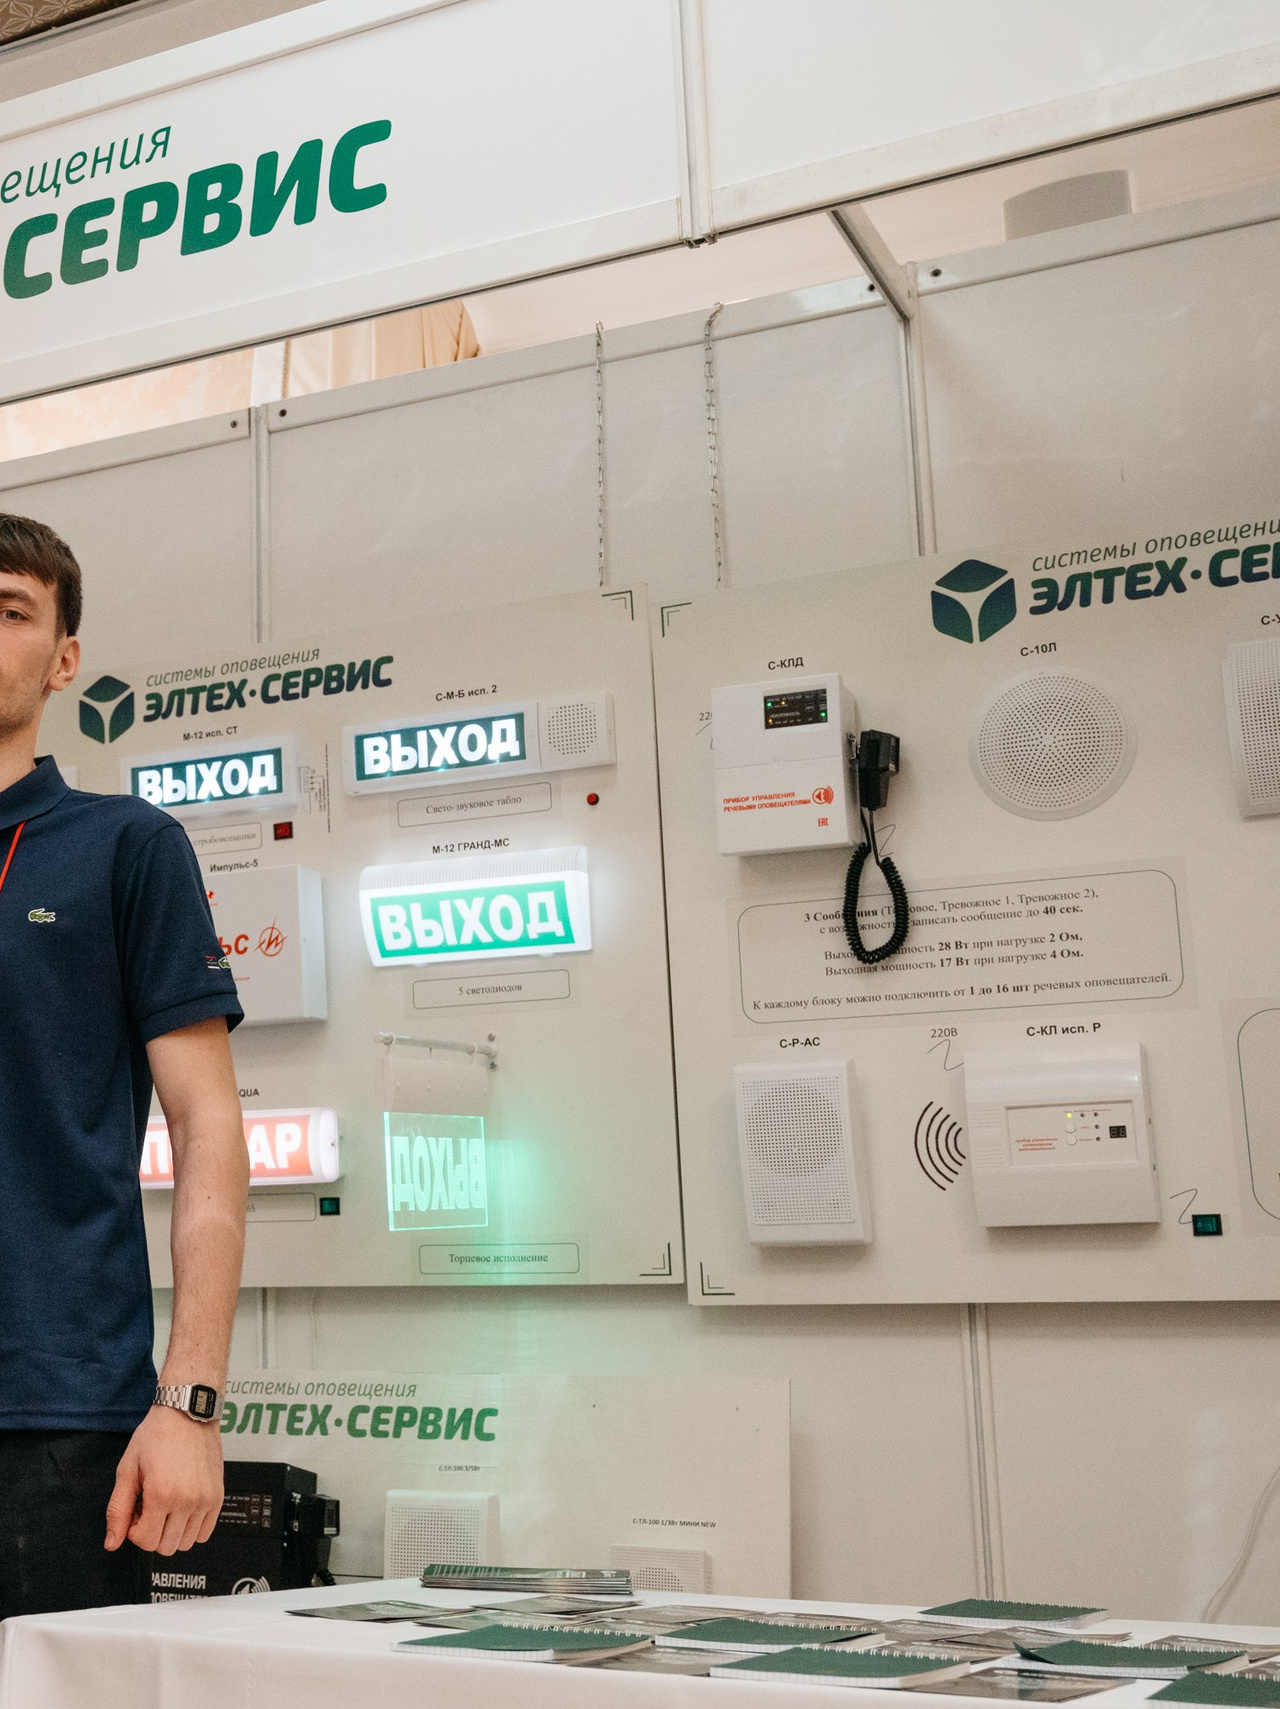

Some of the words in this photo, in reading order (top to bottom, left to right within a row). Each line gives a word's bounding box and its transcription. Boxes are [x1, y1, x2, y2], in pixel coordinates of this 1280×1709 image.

[1032, 541, 1137, 572] системы
[1020, 642, 1057, 657] С-10Л
[146, 663, 216, 687] системы
[220, 648, 321, 676] оповещения
[767, 656, 804, 670] С-КЛД
[435, 688, 465, 702] С-М-Б
[467, 686, 489, 698] исп.
[491, 684, 498, 694] 2
[182, 730, 204, 741] М-12
[205, 728, 224, 739] исп.
[226, 726, 238, 736] СТ
[362, 718, 520, 776] ВЫХОД
[138, 754, 277, 806] ВЫХОД
[425, 799, 494, 815] Свето-звуковое
[497, 795, 522, 805] табло
[723, 796, 750, 805] ПРИБОР
[751, 791, 796, 802] УПРАВЛЕНИЯ
[723, 803, 757, 813] РЕЧЕВЫМИ
[757, 798, 811, 810] ОПОВЕЩАТЕЛЯМИ
[432, 842, 455, 855] М-12
[457, 838, 510, 853] ГРАНД-МС
[209, 858, 259, 873] Импульс-5
[803, 913, 811, 923] 3
[813, 909, 878, 921] Сообния
[940, 898, 1002, 912] Тревожное
[1017, 889, 1081, 905] Тревожное
[378, 890, 565, 951] ВЫХОД
[819, 926, 826, 935] с
[960, 910, 1023, 924] сообщение
[1025, 907, 1040, 919] до
[1042, 905, 1056, 916] 40
[1059, 904, 1084, 914] сек.
[893, 943, 936, 955] щность
[938, 941, 952, 951] 28
[954, 940, 970, 950] Вт
[972, 938, 994, 951] при
[996, 934, 1046, 948] нагрузке
[1048, 933, 1056, 943] 2
[824, 965, 878, 977] Выходная
[881, 960, 937, 973] мощность
[939, 958, 952, 968] 17
[955, 957, 971, 967] Вт
[974, 955, 994, 968] при
[997, 951, 1047, 965] нагрузке
[1049, 949, 1057, 959] 4
[458, 986, 465, 996] 5
[466, 983, 523, 996] светодиодов
[753, 1000, 761, 1010] К
[763, 1000, 810, 1012] каждому
[811, 996, 843, 1008] блоку
[845, 994, 882, 1004] можно
[884, 989, 951, 1002] подключить
[953, 987, 967, 997] от
[969, 986, 975, 996] 1
[978, 986, 992, 996] до
[996, 983, 1009, 994] 16
[1012, 984, 1030, 993] шт
[1033, 980, 1081, 994] речевых
[1026, 1024, 1058, 1038] С-КЛ
[1061, 1023, 1089, 1036] исп.
[779, 1036, 821, 1049] С-Р-АС
[238, 1088, 260, 1098] QUA
[140, 1122, 303, 1175] ПАР
[448, 1253, 491, 1265] Торцевое
[493, 1254, 548, 1265] исполнение
[303, 1379, 418, 1400] оповещения
[151, 1572, 207, 1590] АВЛЕНИЯ
